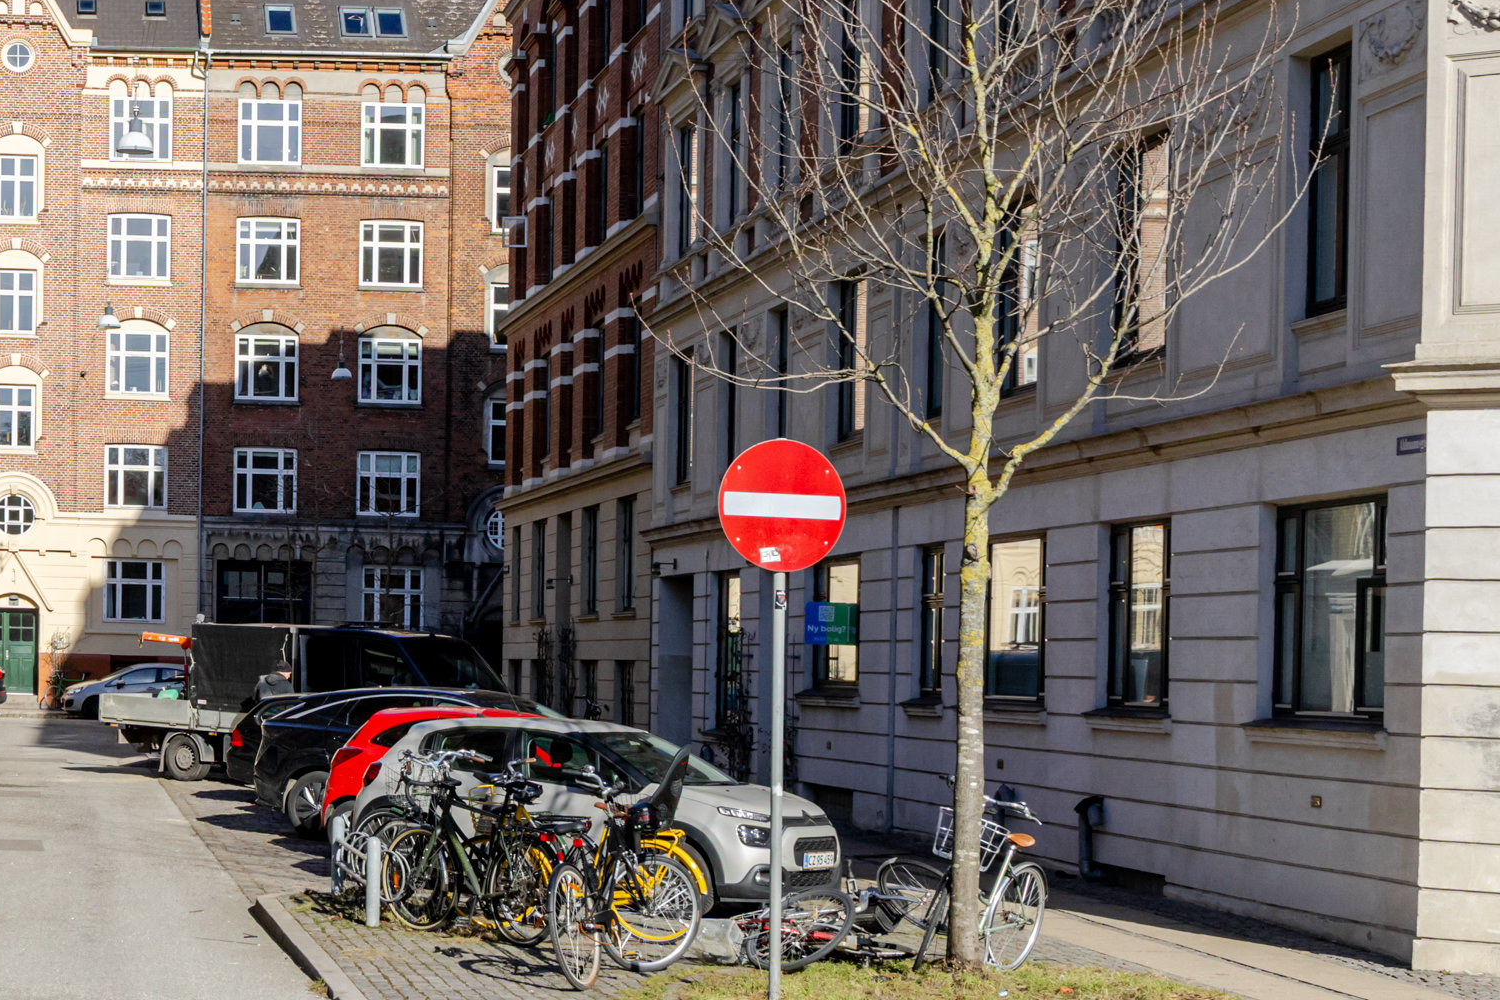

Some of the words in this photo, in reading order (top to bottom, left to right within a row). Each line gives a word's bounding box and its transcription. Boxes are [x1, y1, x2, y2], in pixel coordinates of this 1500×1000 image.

[807, 624, 819, 634] Ny
[820, 625, 847, 635] bolig?
[808, 855, 816, 866] CZ
